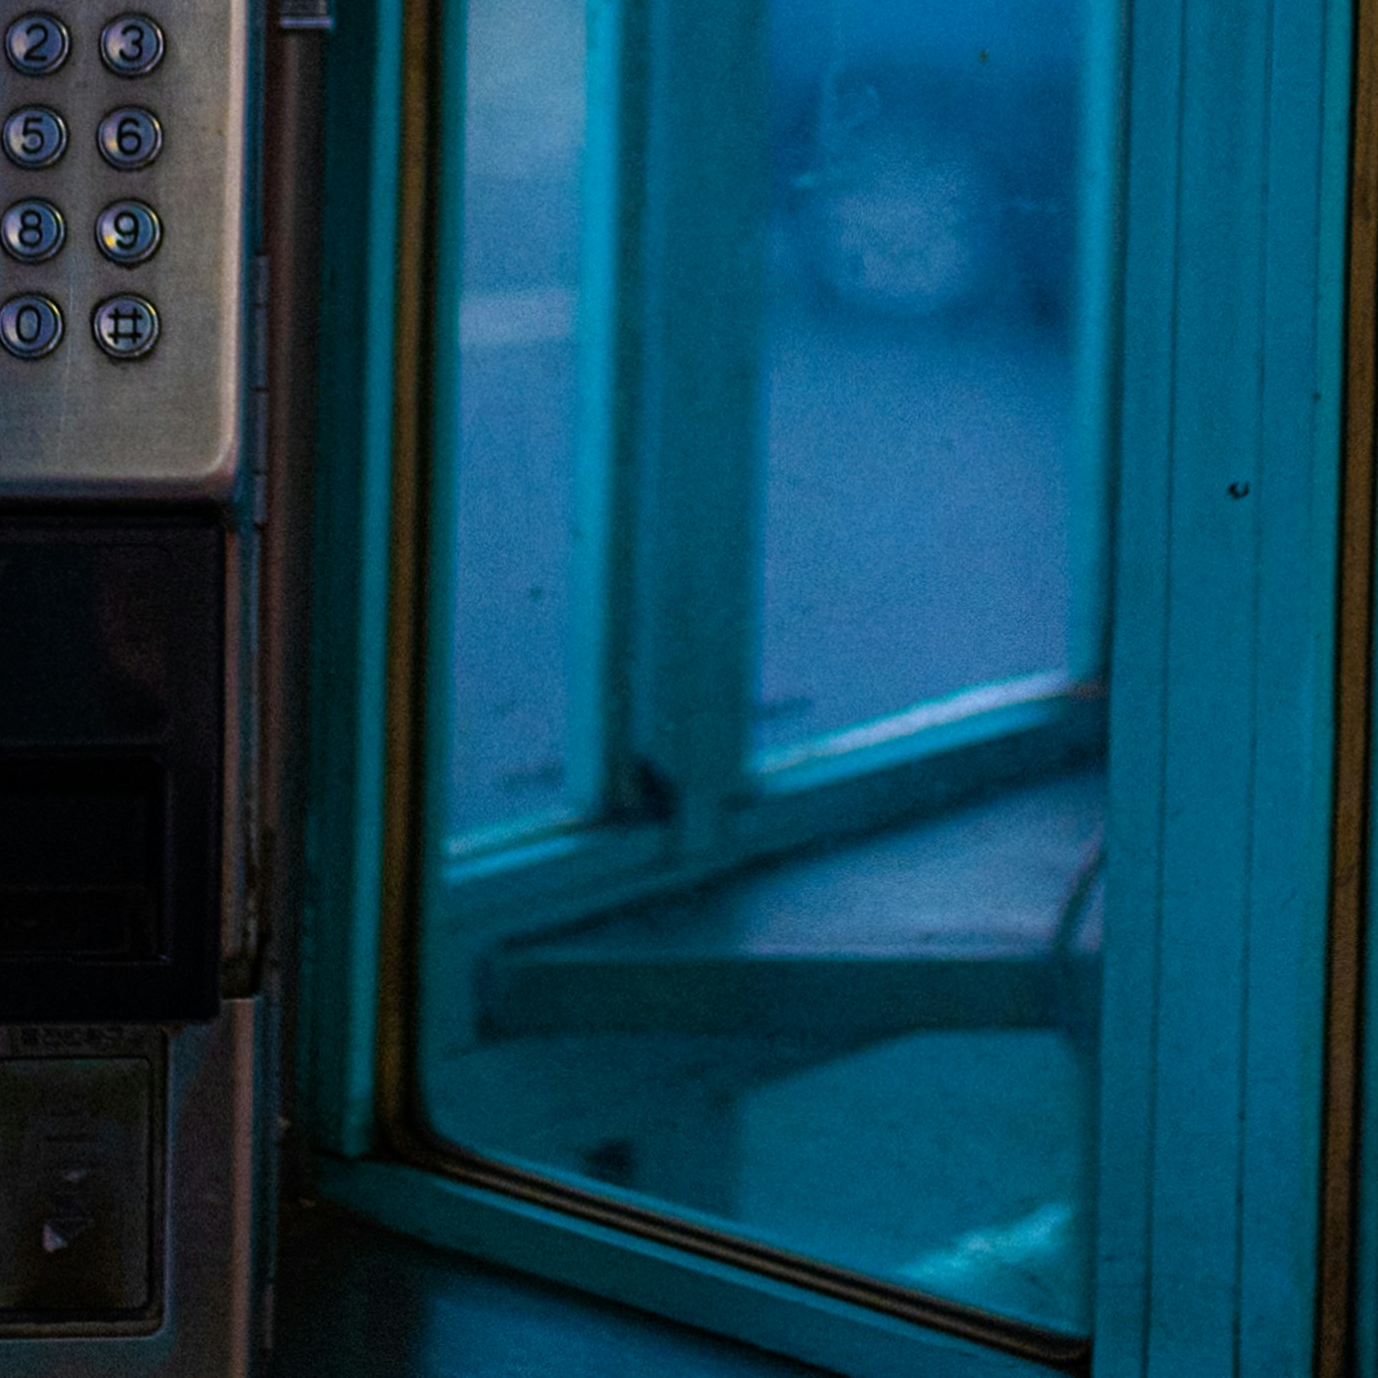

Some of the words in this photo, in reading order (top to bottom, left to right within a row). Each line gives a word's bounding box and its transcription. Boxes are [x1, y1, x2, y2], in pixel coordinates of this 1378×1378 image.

[24, 24, 48, 61] 2
[119, 25, 144, 62] 3
[22, 117, 44, 154] 5
[118, 118, 141, 155] 6
[19, 210, 42, 247] 8
[114, 212, 138, 249] 9
[16, 306, 41, 342] 0
